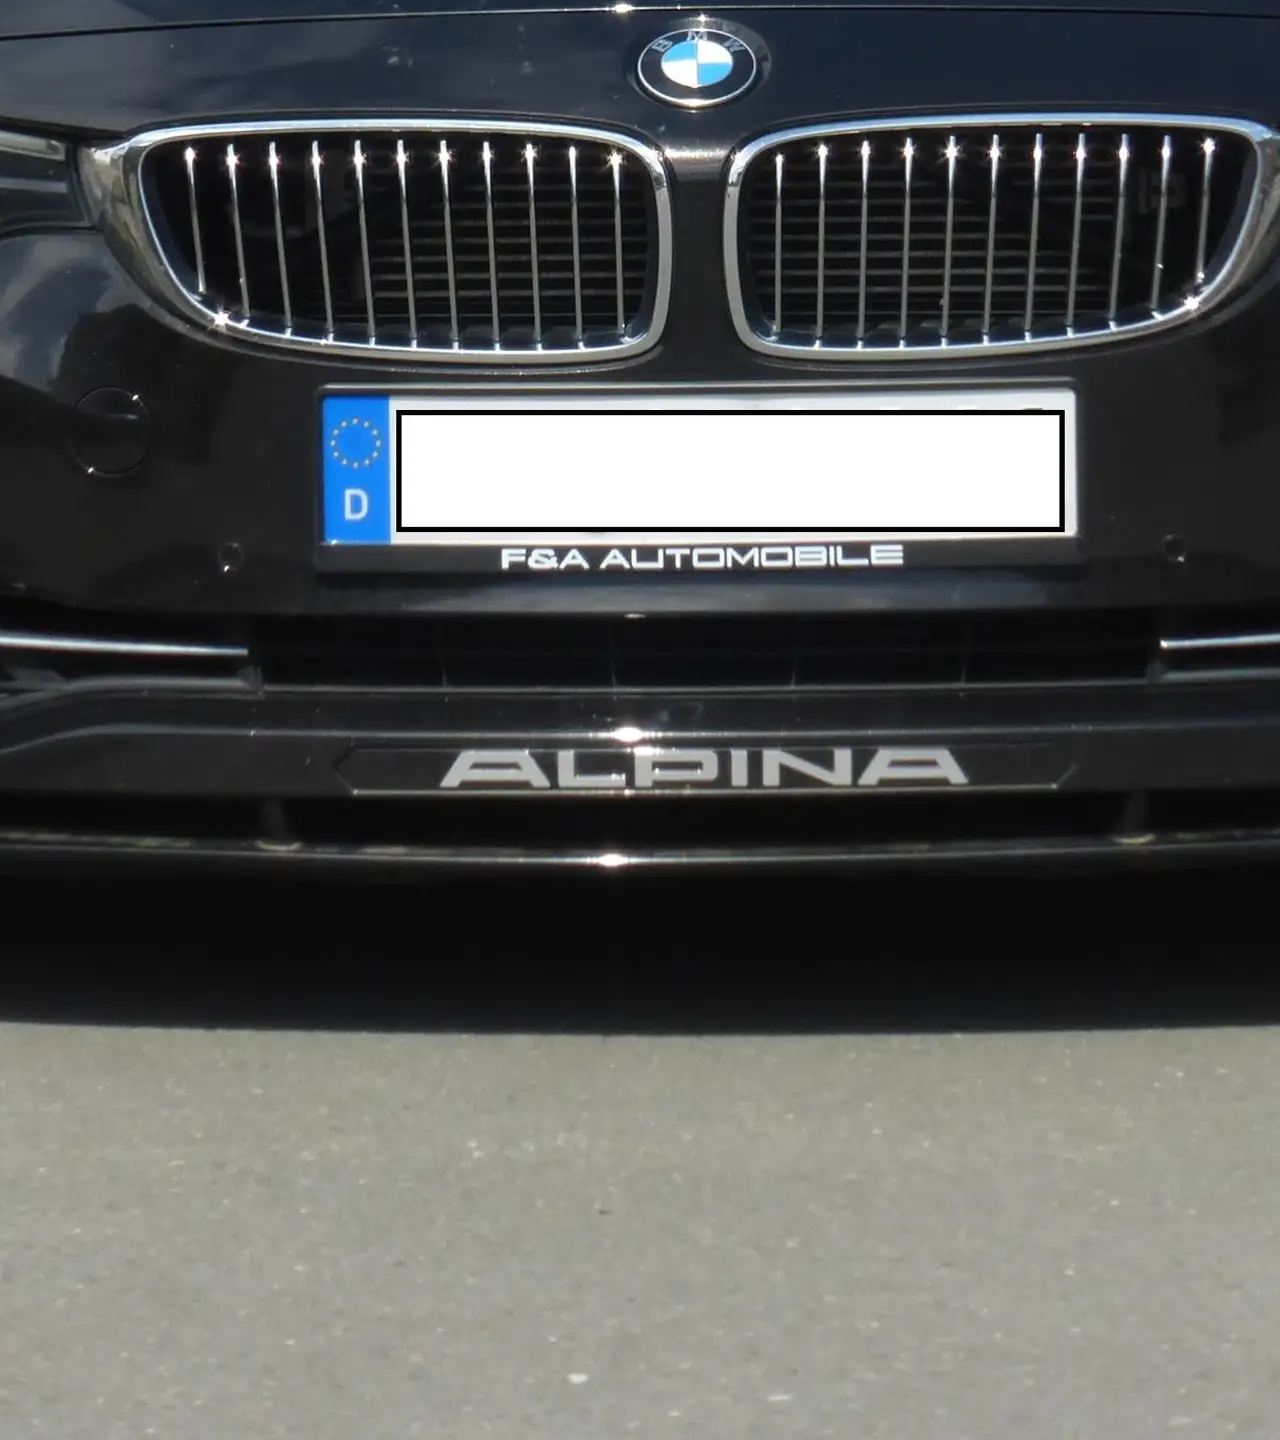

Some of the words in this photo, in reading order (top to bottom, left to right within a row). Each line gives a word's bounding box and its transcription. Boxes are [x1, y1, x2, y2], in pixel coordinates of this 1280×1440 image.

[650, 29, 745, 53] BMW
[344, 488, 369, 520] D
[501, 547, 589, 571] F&A
[599, 544, 905, 570] AUTOMOBILE
[439, 747, 970, 789] ALPINA
